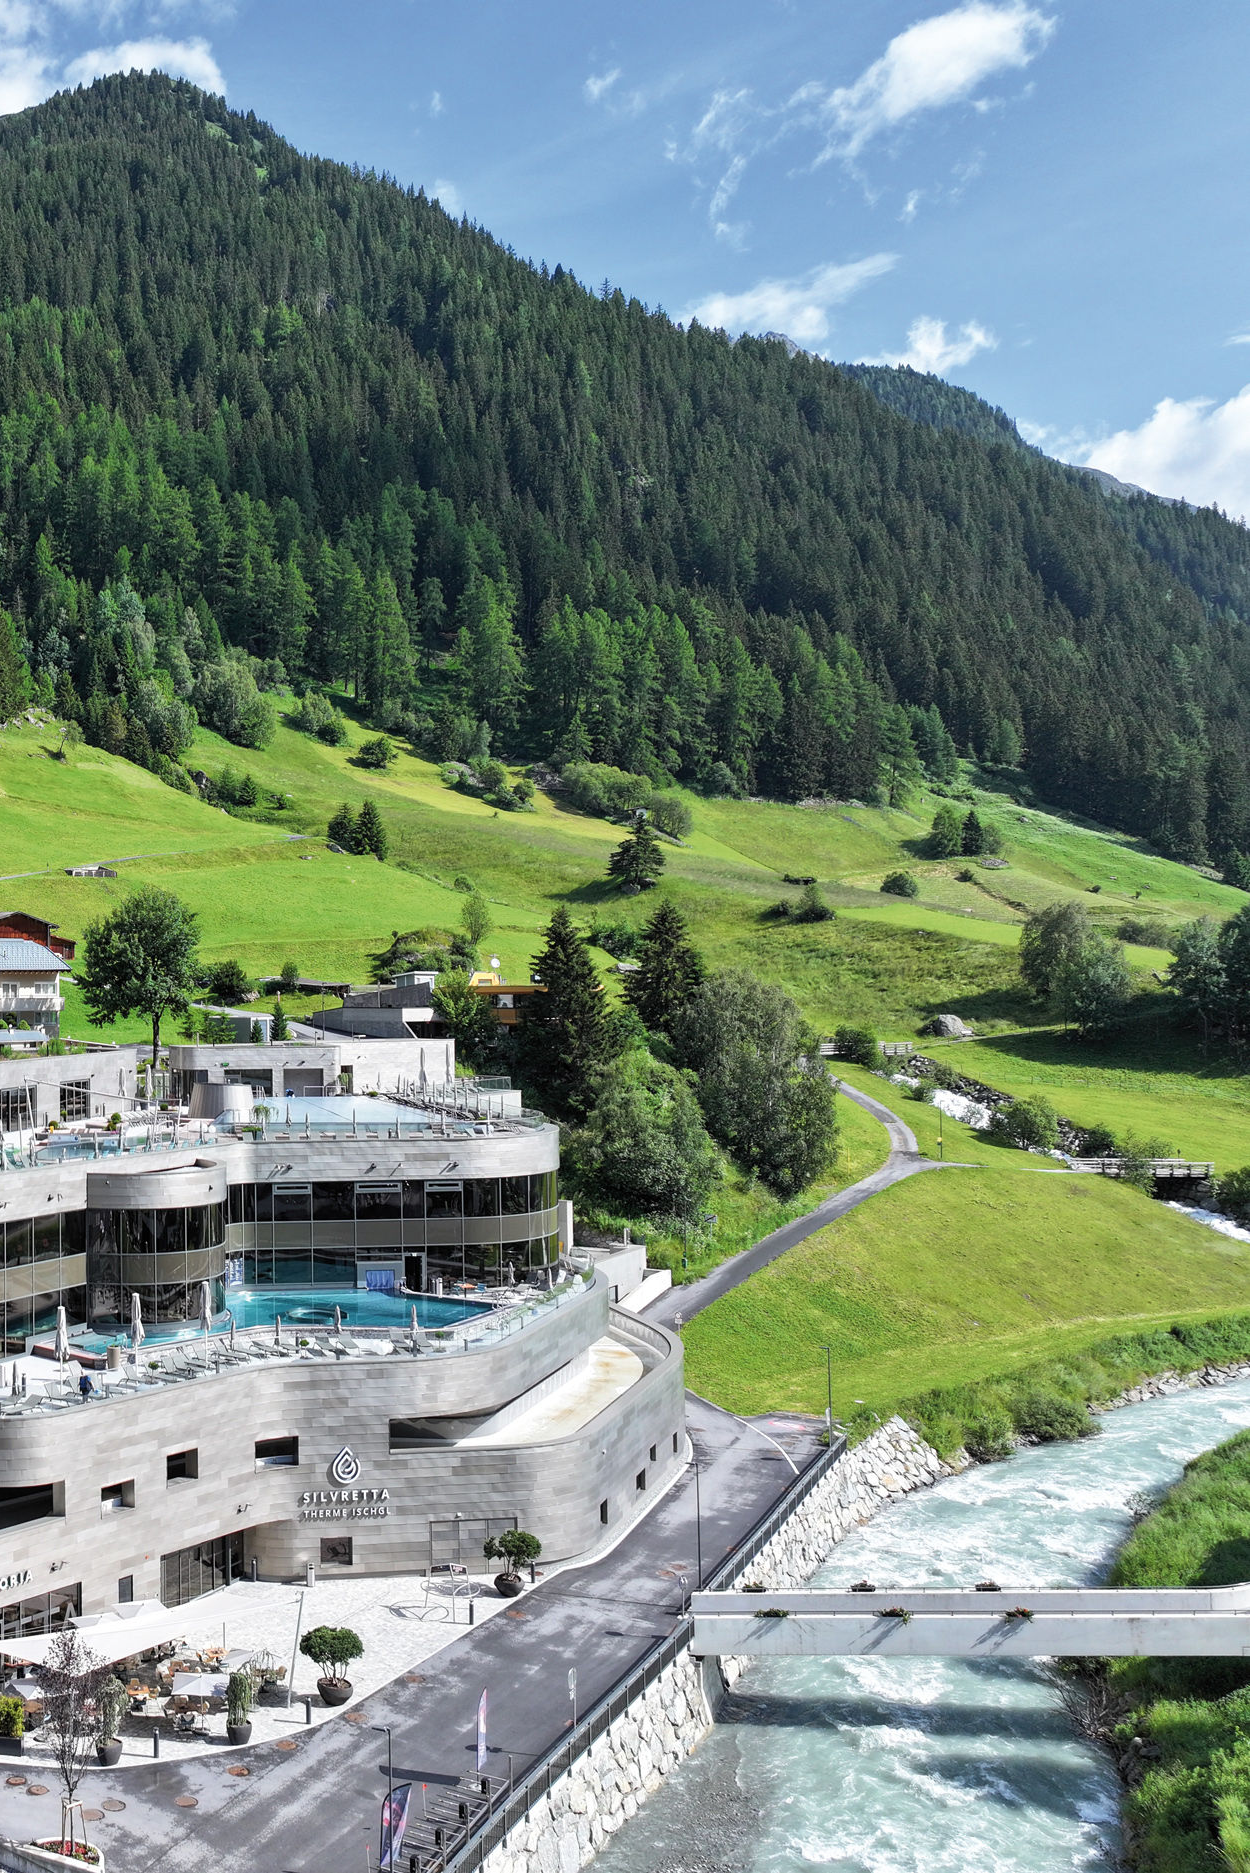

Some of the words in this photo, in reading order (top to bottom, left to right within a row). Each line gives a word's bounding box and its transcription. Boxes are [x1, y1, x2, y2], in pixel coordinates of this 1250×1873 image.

[303, 1489, 390, 1503] SILVRETTA
[304, 1509, 347, 1518] THERME
[352, 1506, 391, 1516] ISCHGL
